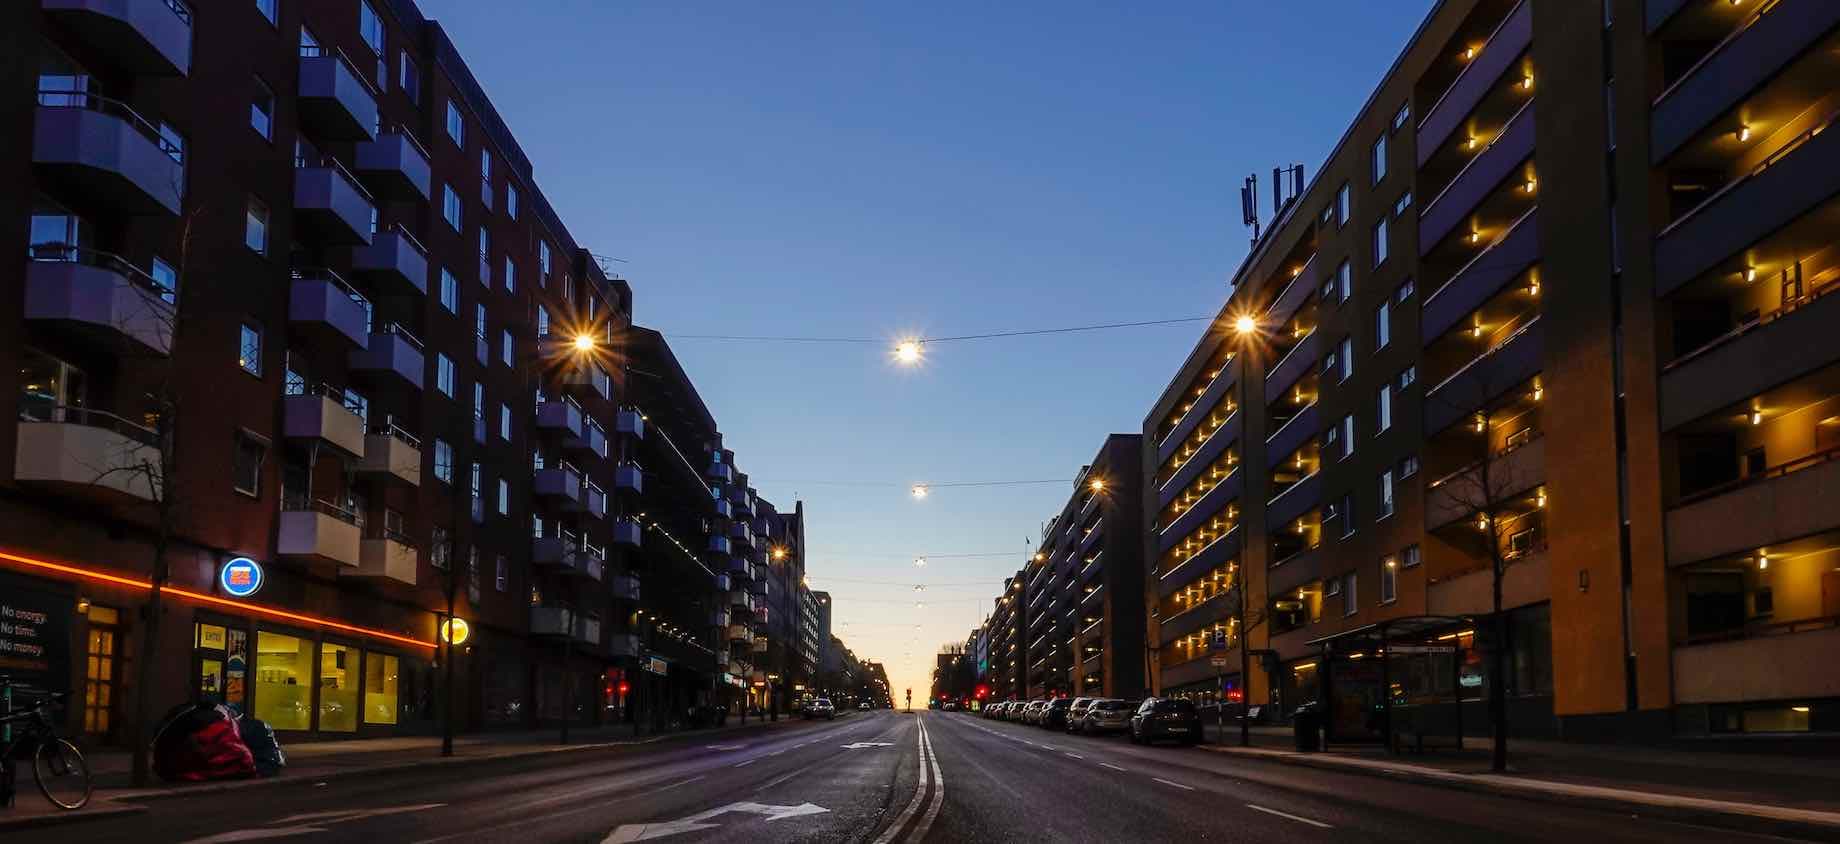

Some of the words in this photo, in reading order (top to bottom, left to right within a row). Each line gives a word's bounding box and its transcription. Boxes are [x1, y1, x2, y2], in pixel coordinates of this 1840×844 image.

[1, 605, 14, 617] No
[0, 622, 13, 634] No
[1215, 631, 1223, 641] P
[0, 639, 12, 651] No
